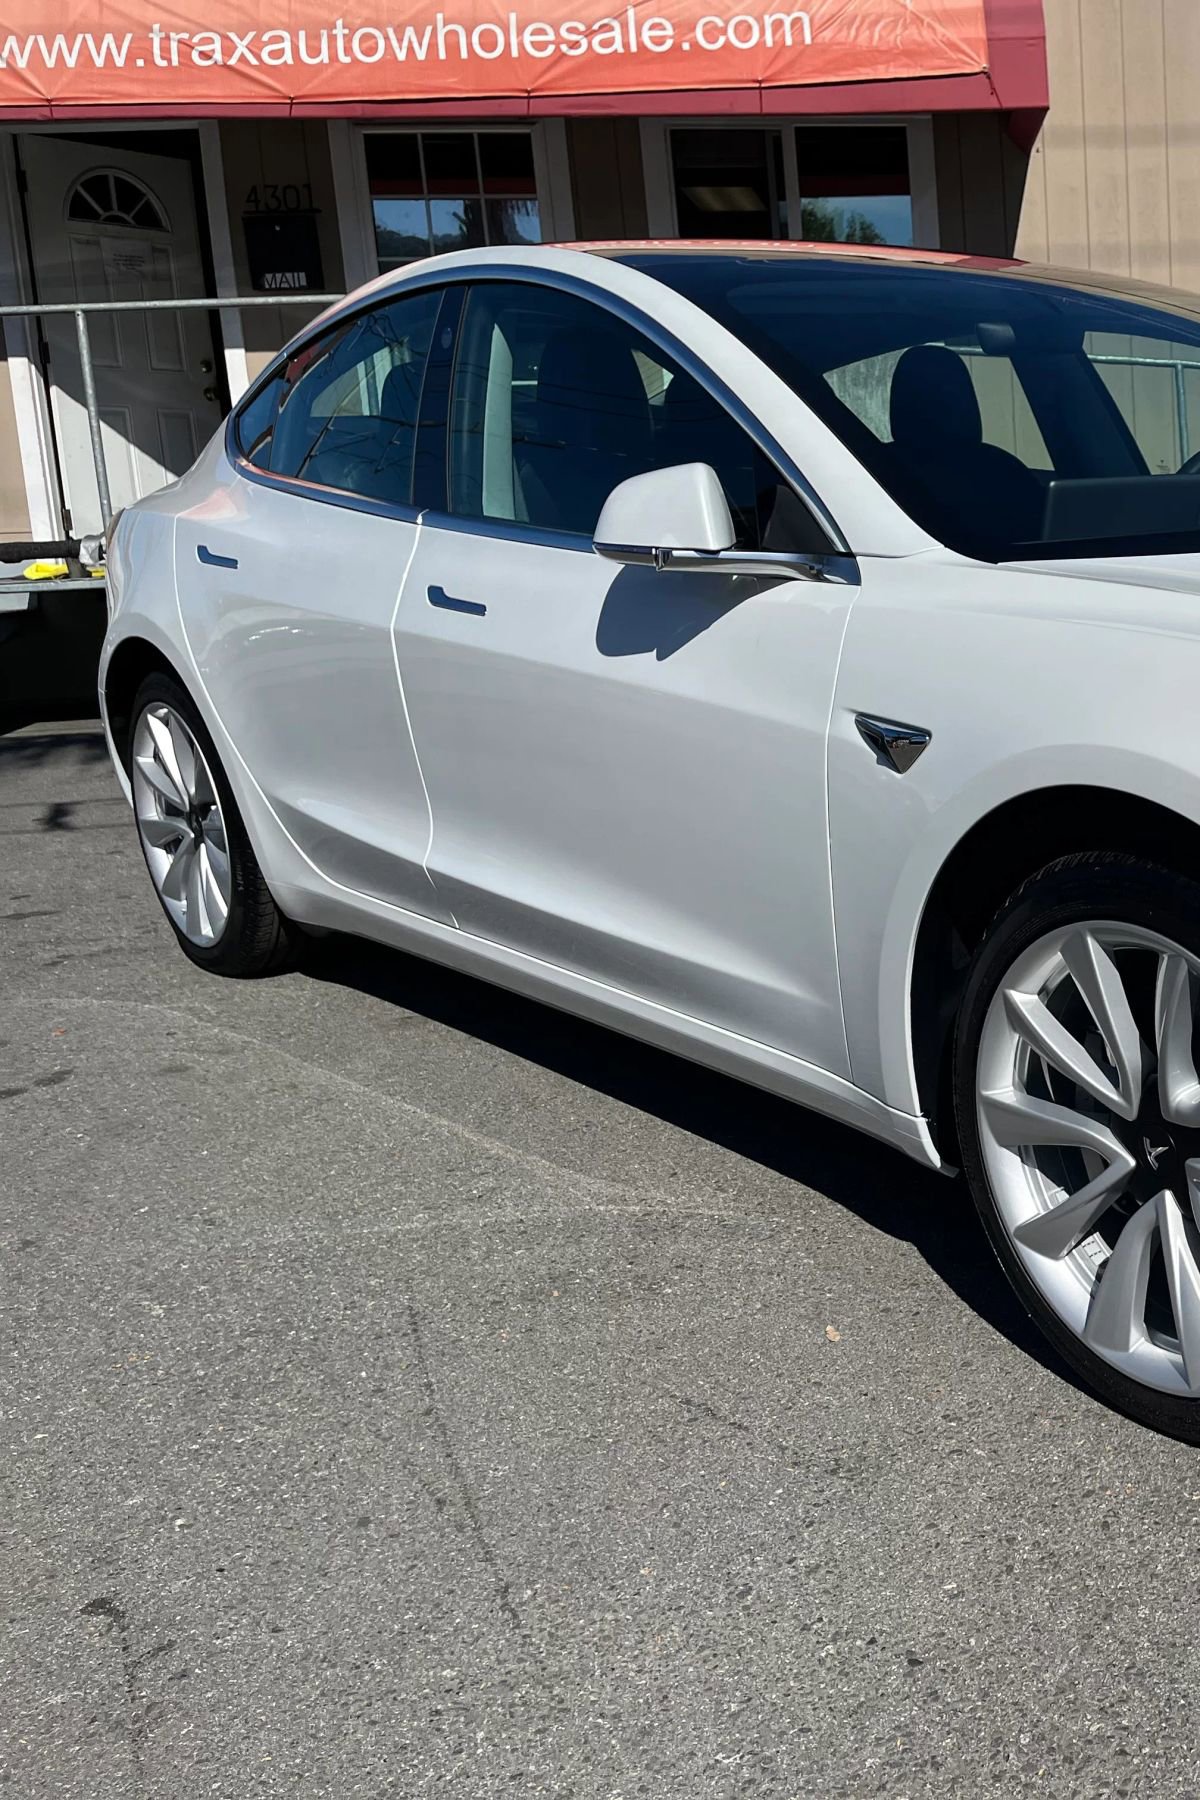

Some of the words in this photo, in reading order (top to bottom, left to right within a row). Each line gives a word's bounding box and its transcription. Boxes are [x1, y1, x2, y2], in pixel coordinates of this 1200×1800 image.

[0, 5, 812, 69] www.traxautowholesale.com
[245, 183, 314, 211] 4301
[264, 272, 308, 289] MAIL
